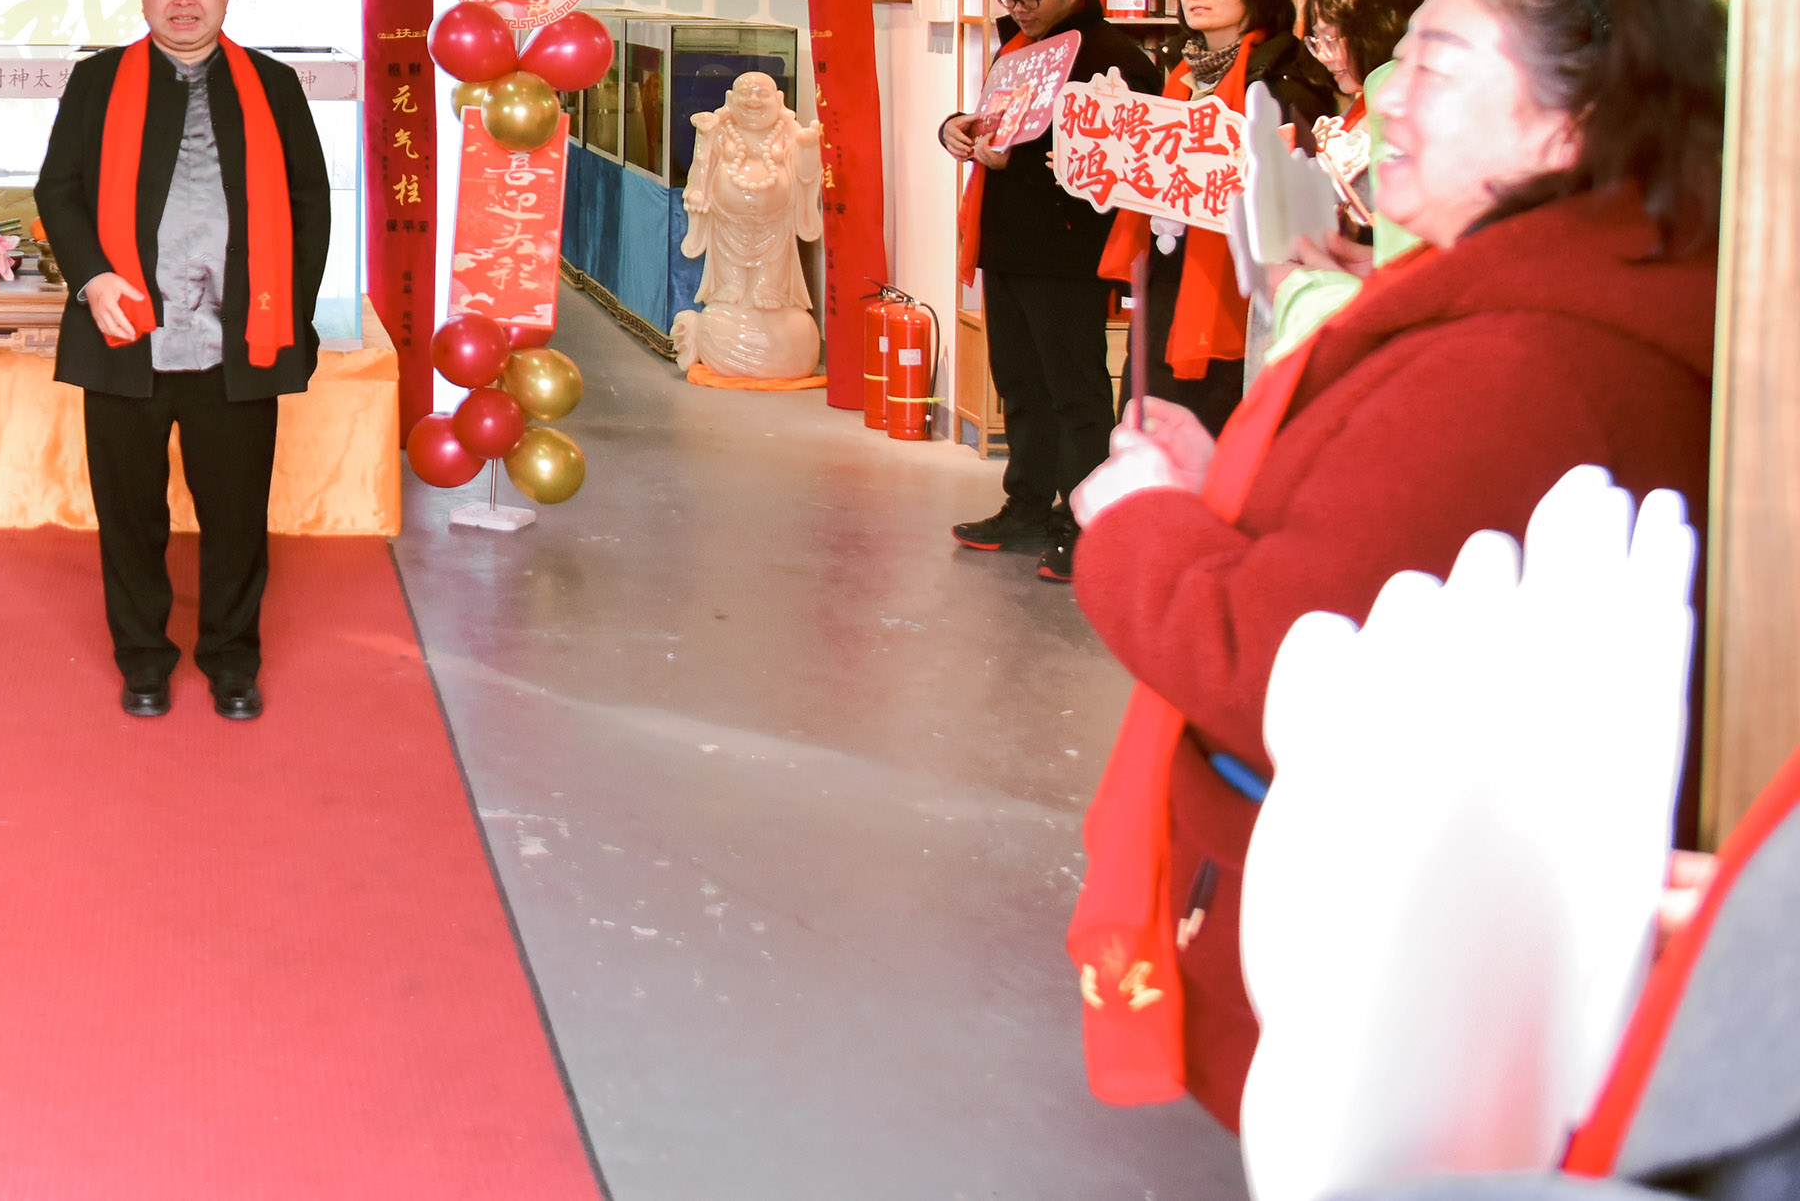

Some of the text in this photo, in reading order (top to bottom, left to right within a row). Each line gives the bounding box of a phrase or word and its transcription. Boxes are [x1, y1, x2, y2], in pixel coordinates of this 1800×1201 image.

[390, 84, 423, 207] 元气柱
[1059, 92, 1230, 164] 驰骋万里
[484, 151, 554, 290] 喜迎头彩
[1066, 140, 1246, 217] 鸿运奔腾
